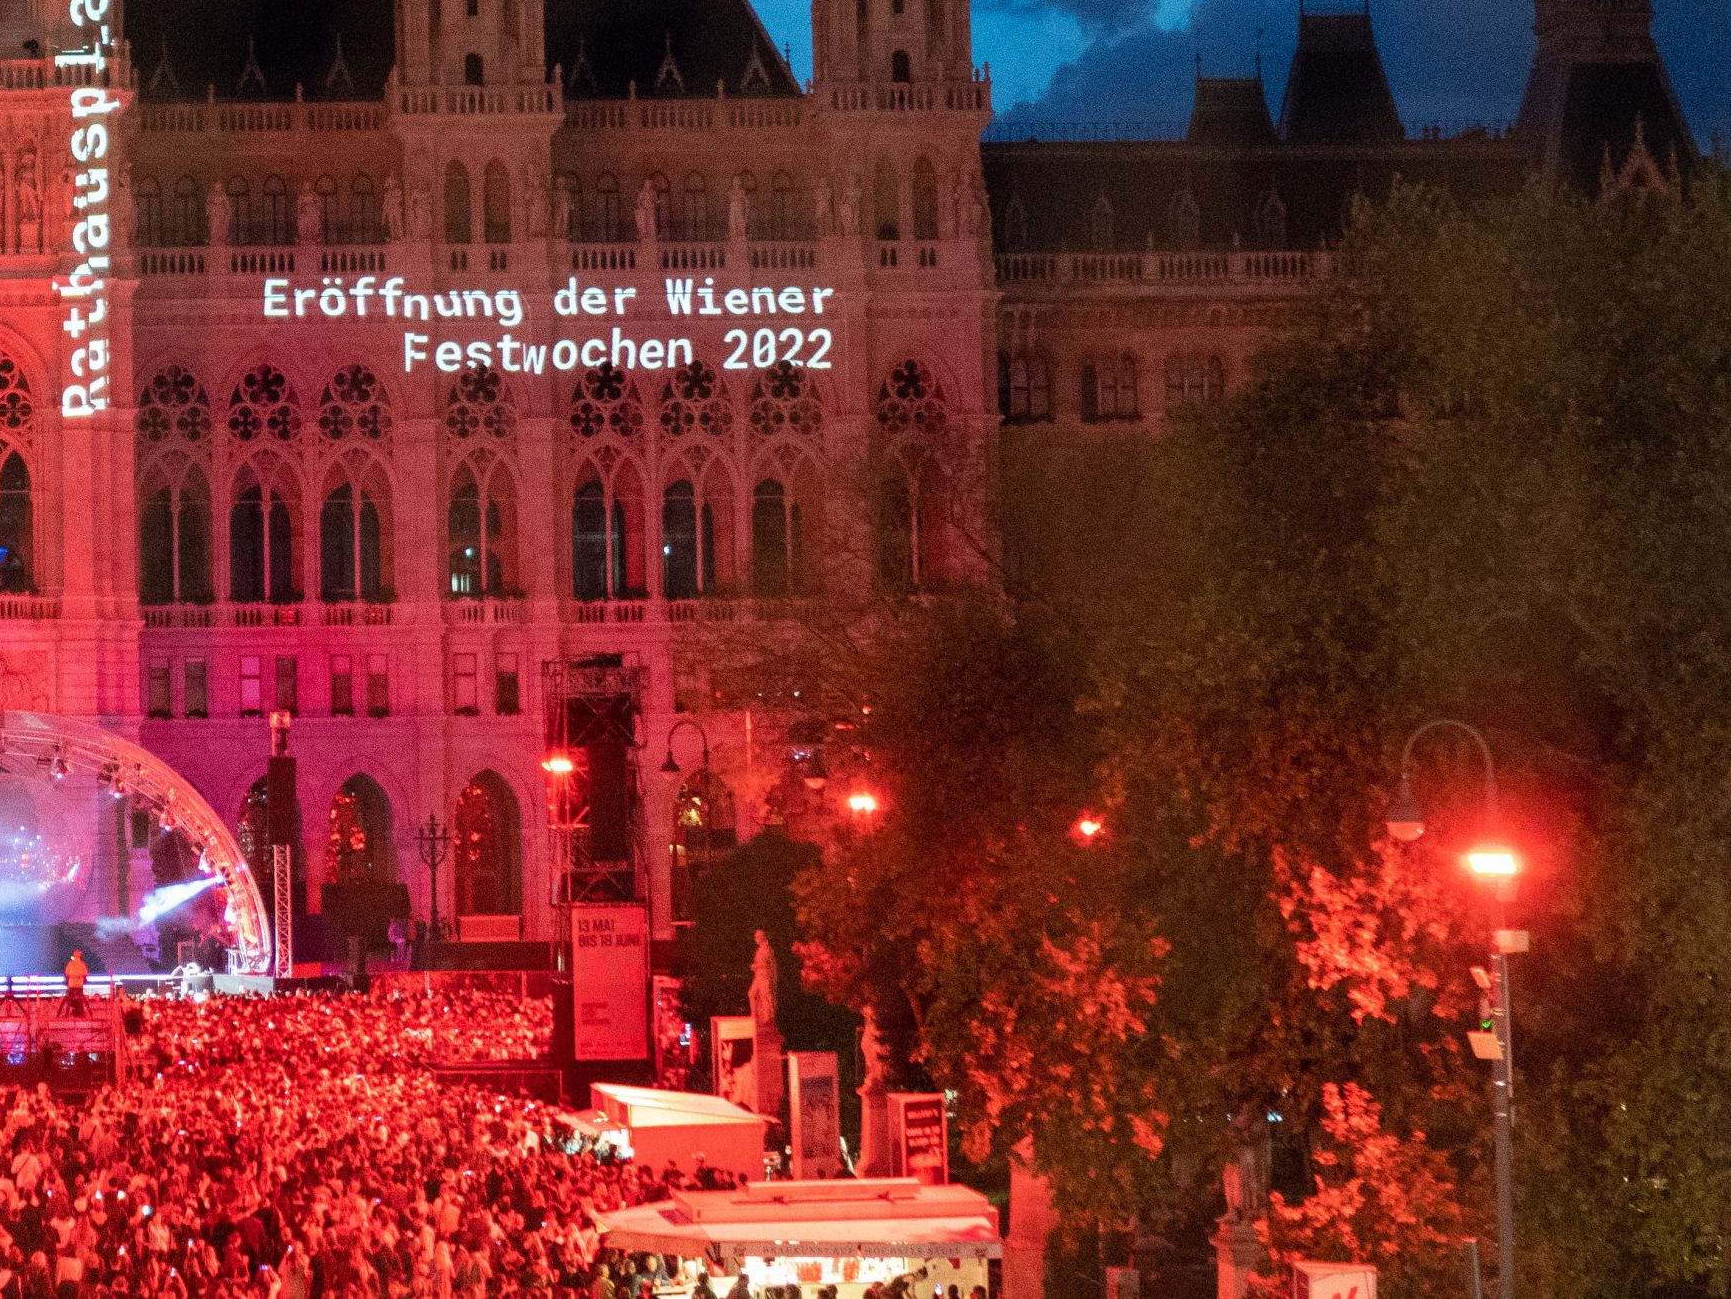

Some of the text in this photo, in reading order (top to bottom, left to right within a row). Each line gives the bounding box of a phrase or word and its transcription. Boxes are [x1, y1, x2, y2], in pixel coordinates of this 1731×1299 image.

[263, 276, 834, 326] Eröffnung der Wiener
[404, 328, 832, 375] Festwochen 2022
[578, 919, 589, 932] 13
